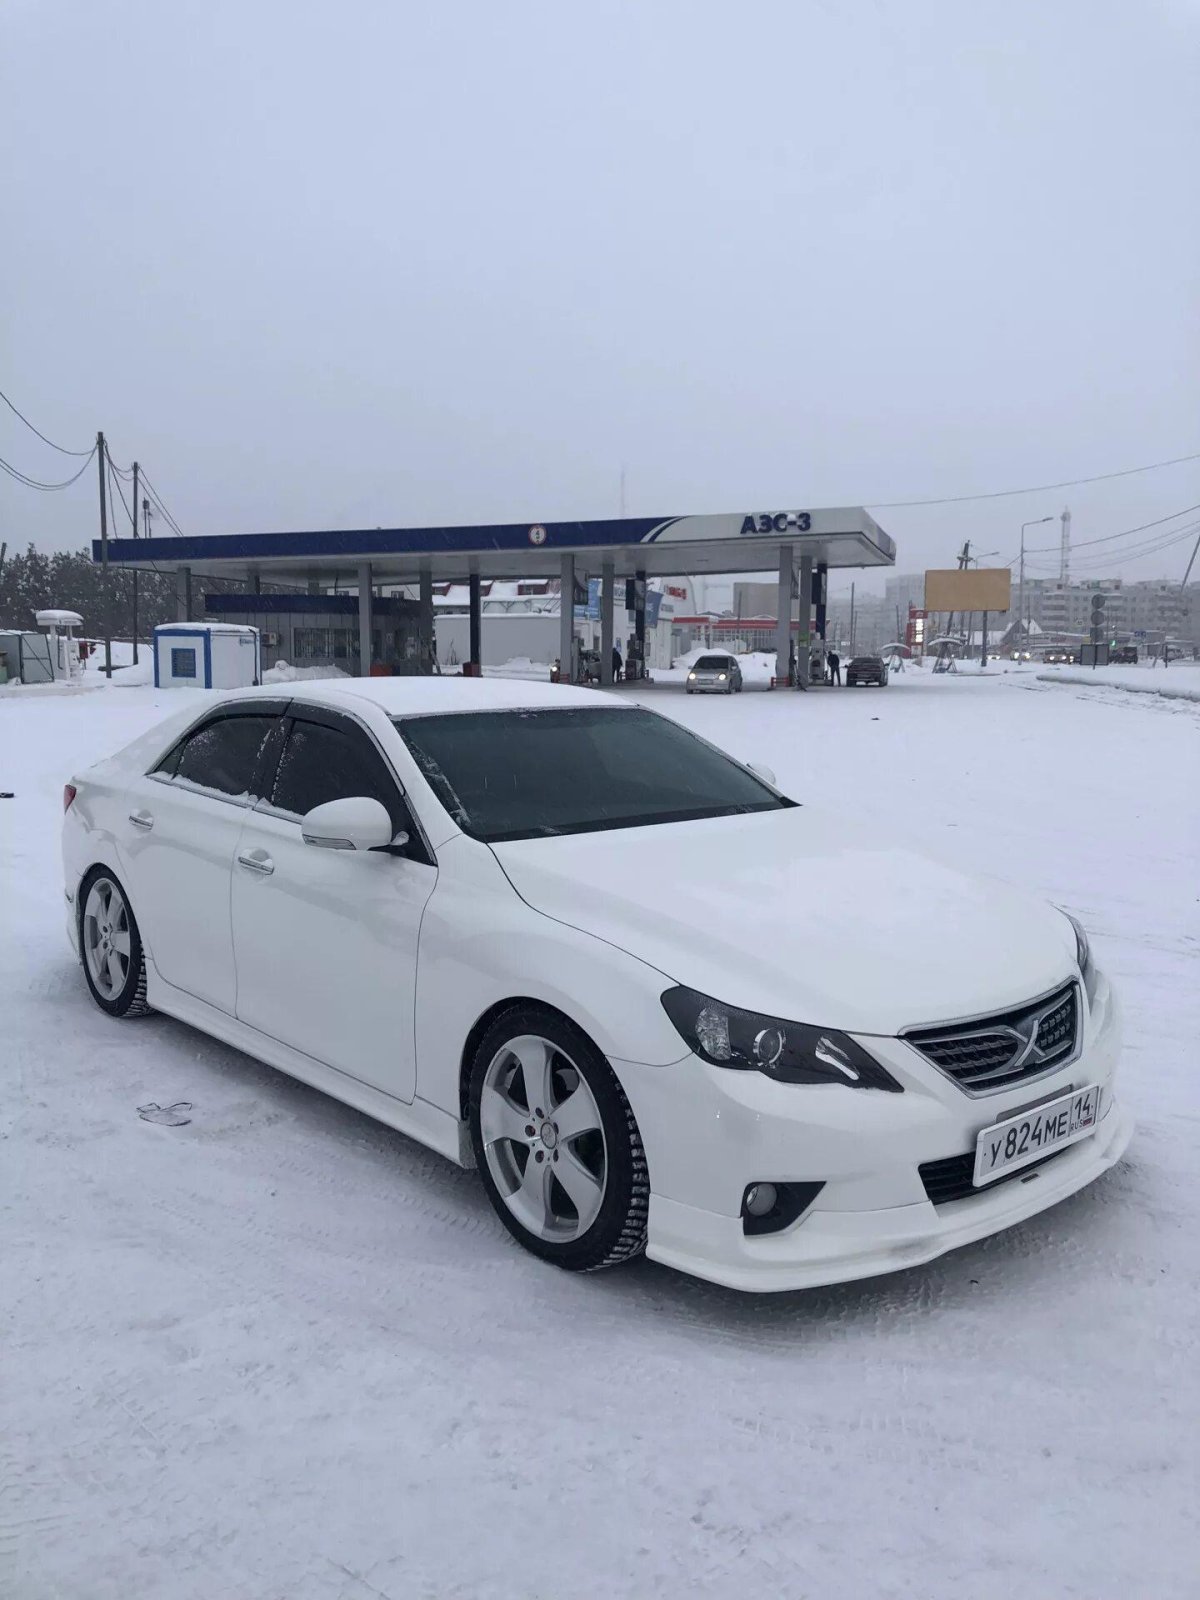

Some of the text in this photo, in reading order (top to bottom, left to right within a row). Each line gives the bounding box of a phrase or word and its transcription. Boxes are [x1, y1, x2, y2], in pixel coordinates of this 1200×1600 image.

[740, 512, 811, 534] АЗС-3
[1074, 1094, 1091, 1120] 14
[1070, 1119, 1083, 1131] RUS
